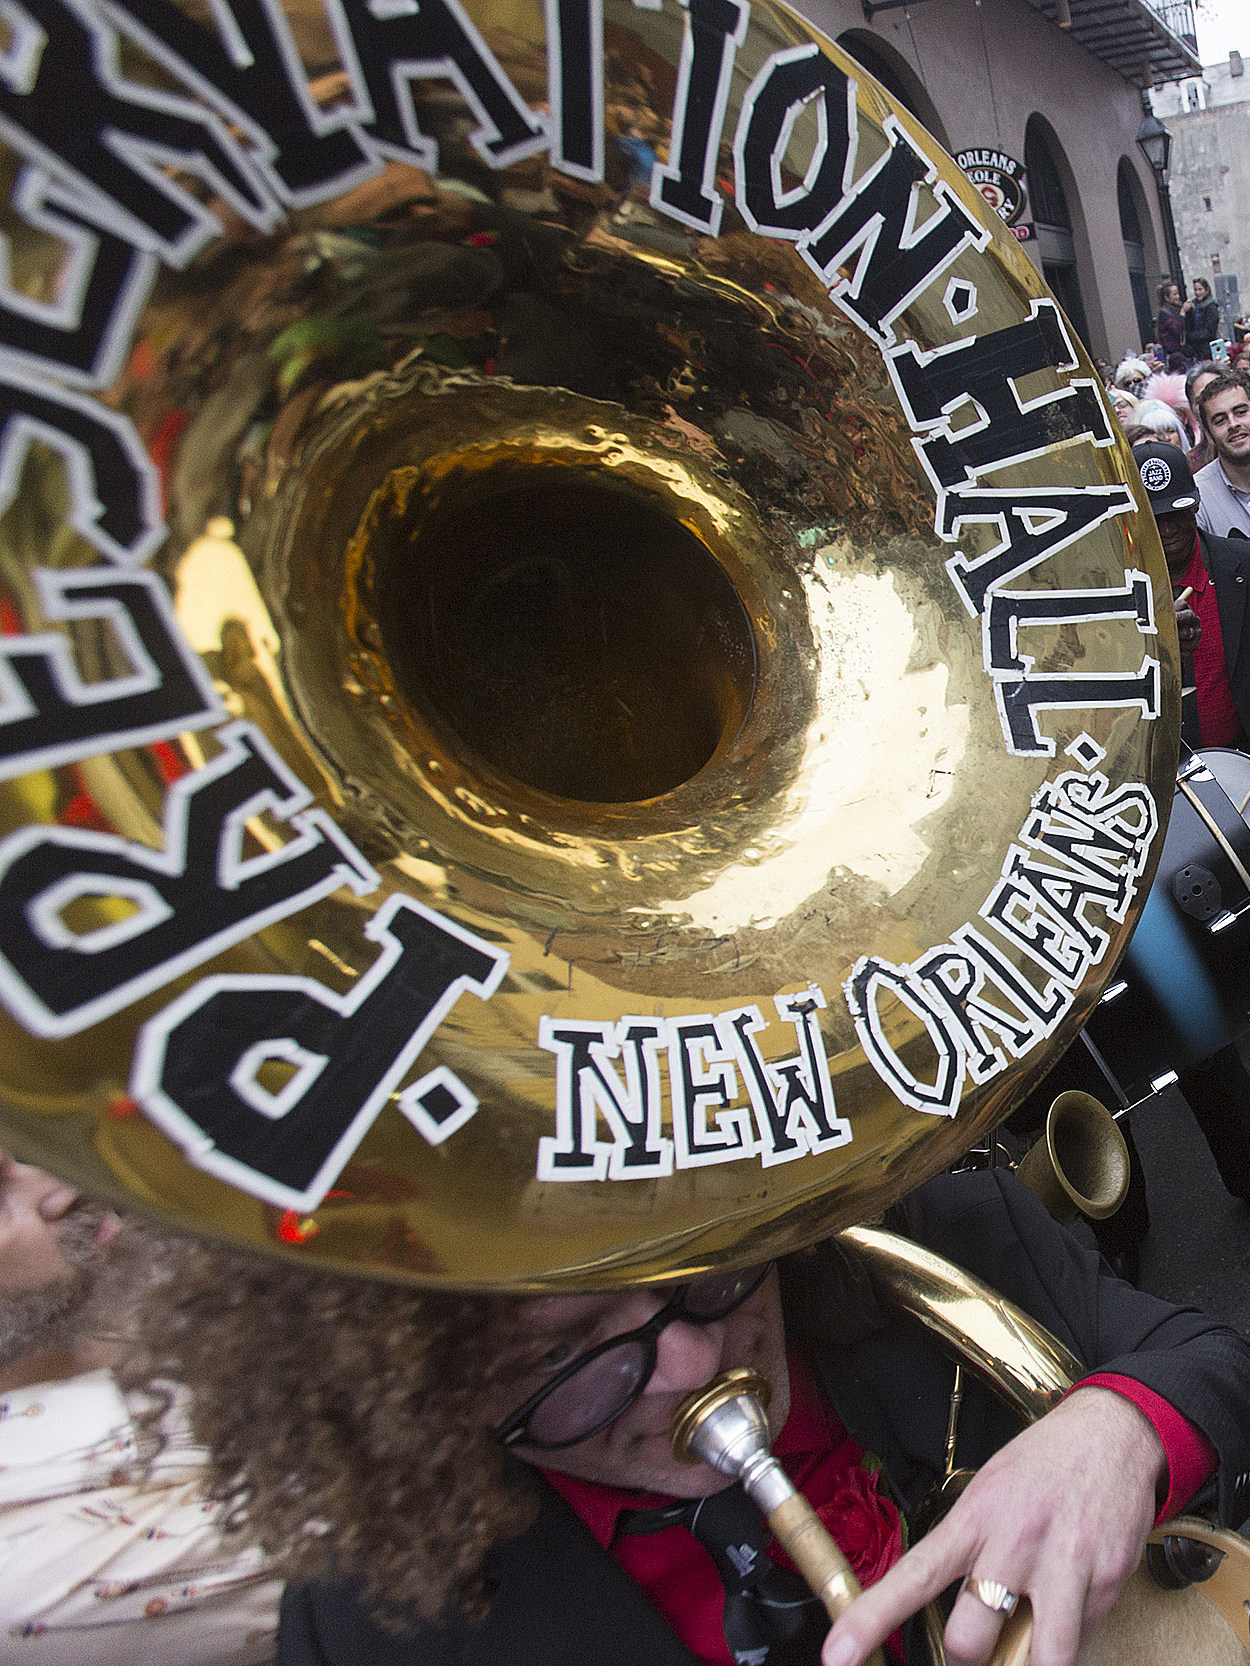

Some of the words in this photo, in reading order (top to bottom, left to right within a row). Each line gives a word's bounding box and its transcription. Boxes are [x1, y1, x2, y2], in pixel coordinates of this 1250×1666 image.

[957, 150, 1017, 175] ORLEANS
[882, 298, 1161, 758] HALL
[1148, 468, 1163, 476] JAZZ
[536, 982, 853, 1182] NEW
[851, 769, 1159, 1118] ORLEANS
